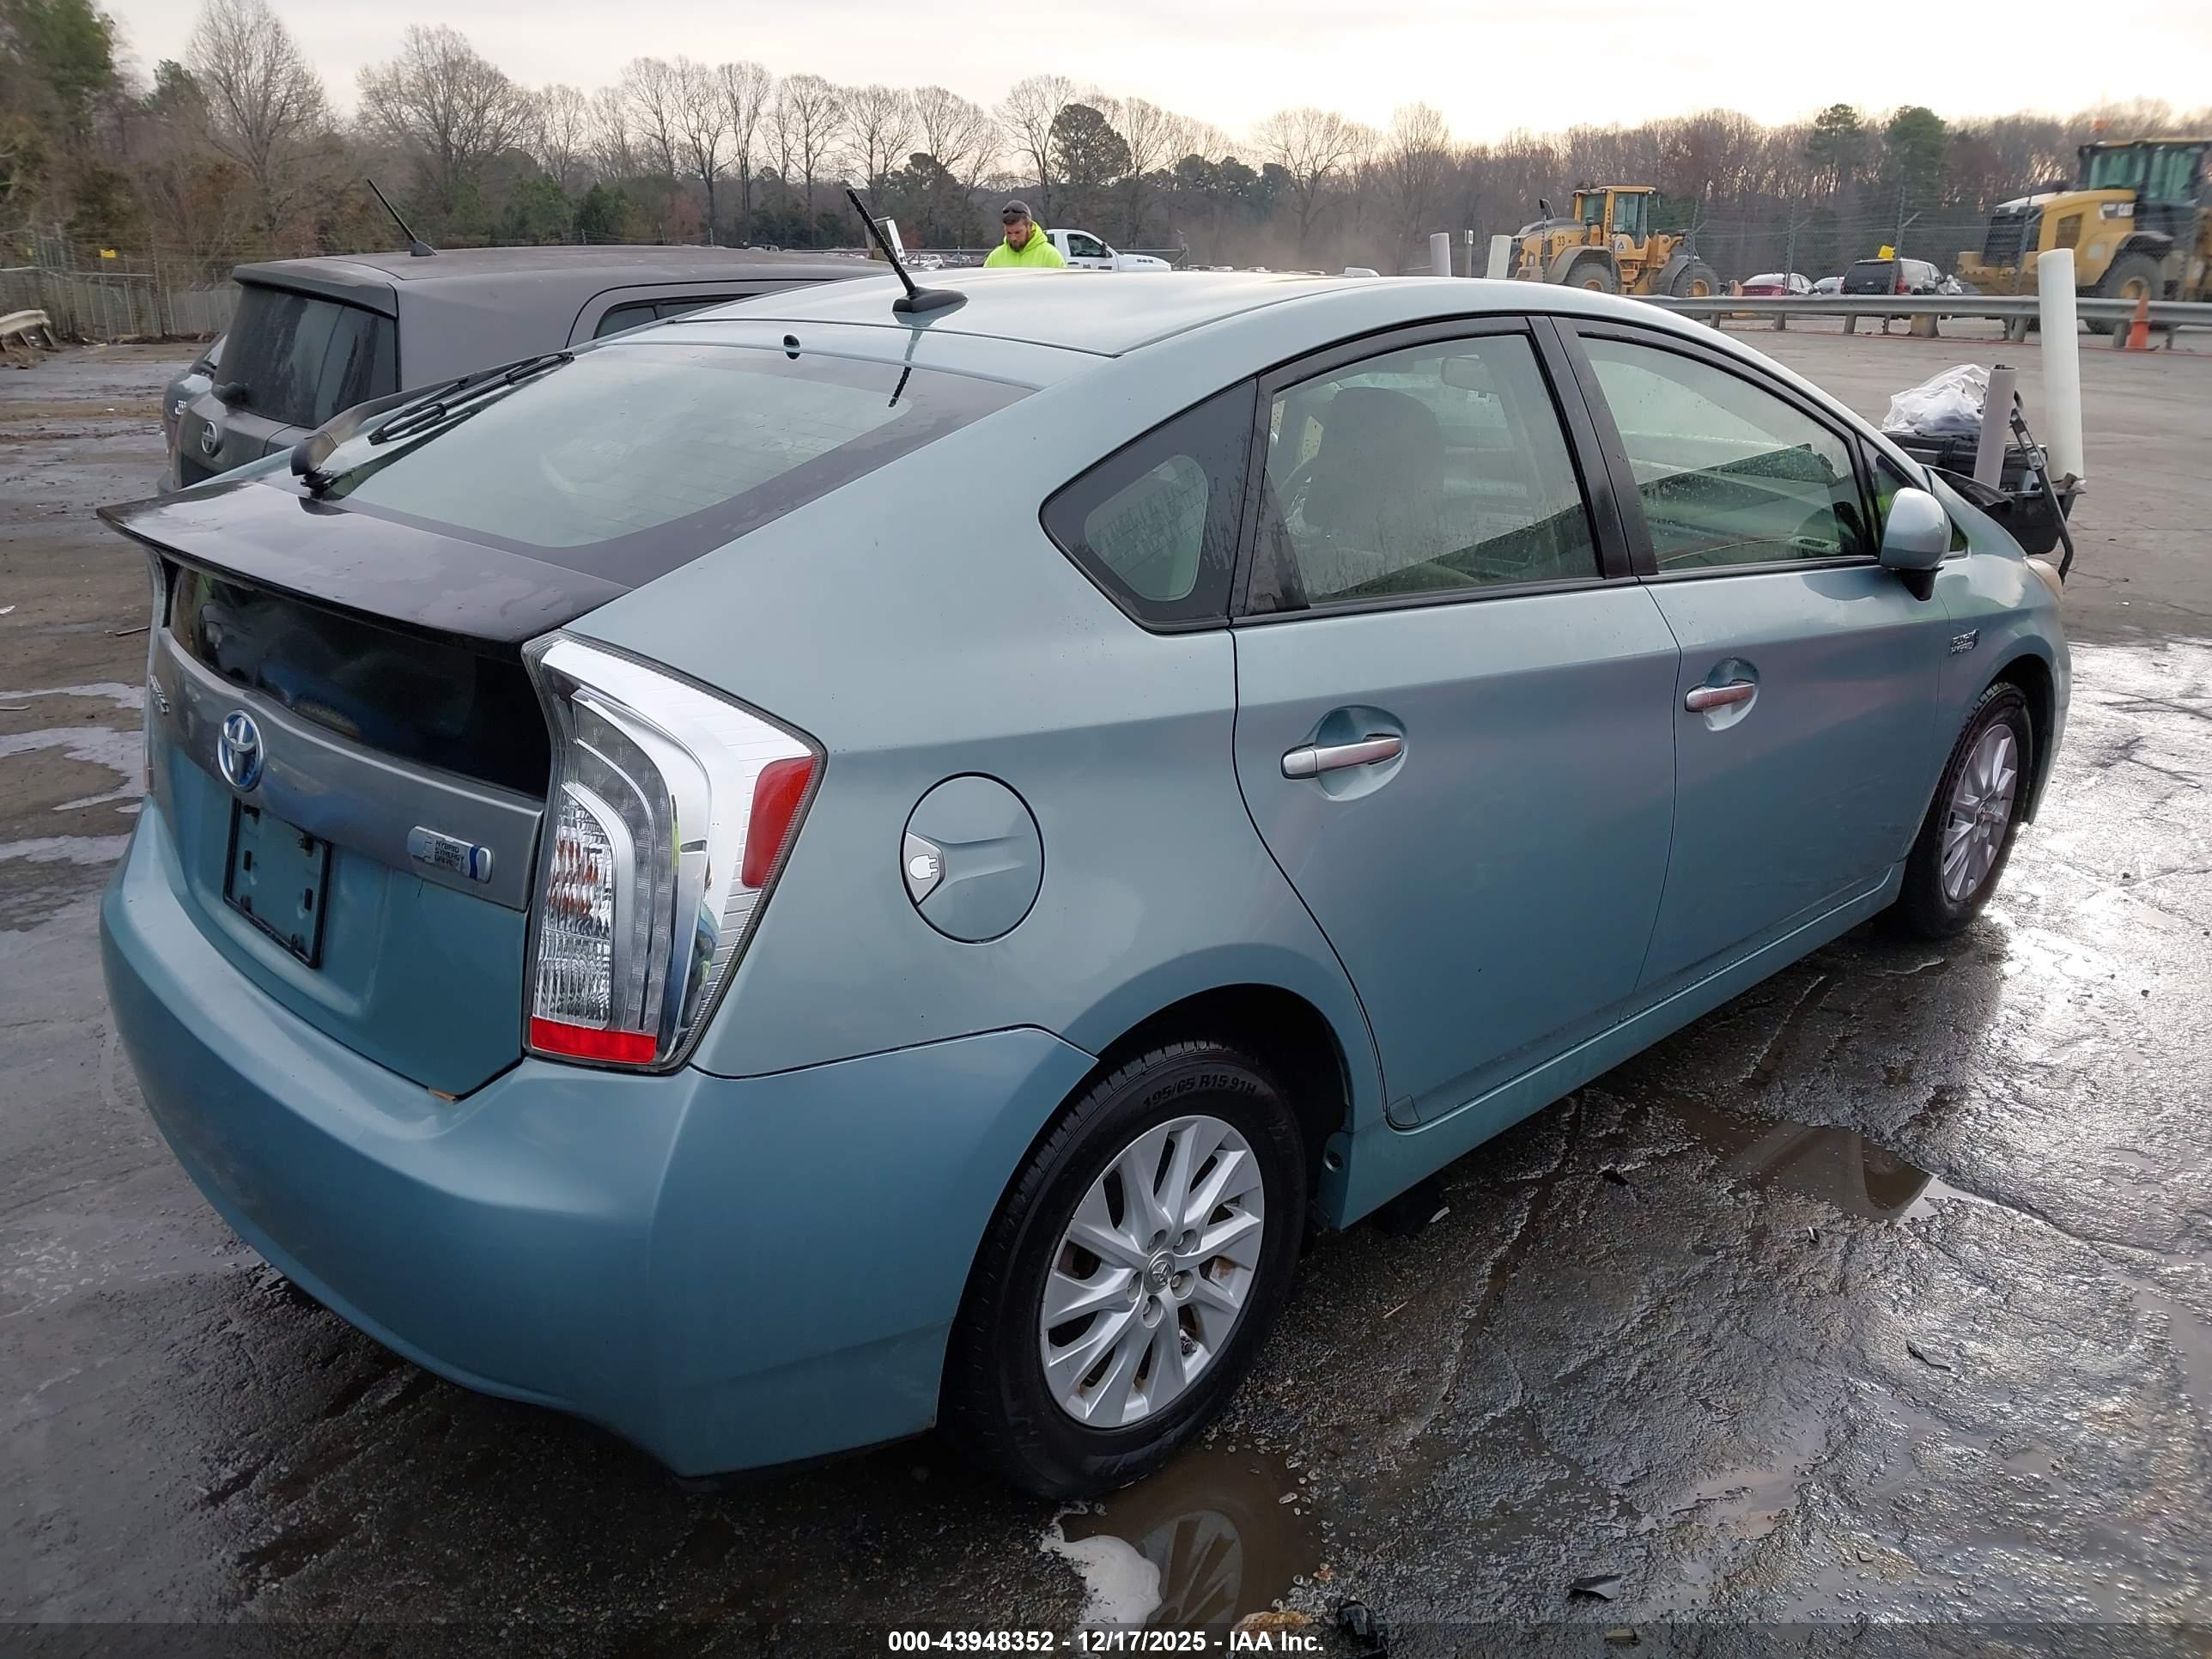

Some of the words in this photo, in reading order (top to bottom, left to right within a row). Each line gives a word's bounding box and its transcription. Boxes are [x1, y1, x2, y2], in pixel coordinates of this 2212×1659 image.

[1557, 236, 1565, 246] 33
[434, 847, 465, 861] SYNERGY
[435, 840, 460, 854] HYBRID
[1143, 1077, 1195, 1106] 195/65
[1199, 1074, 1227, 1088] R15
[1229, 1077, 1256, 1093] 91H
